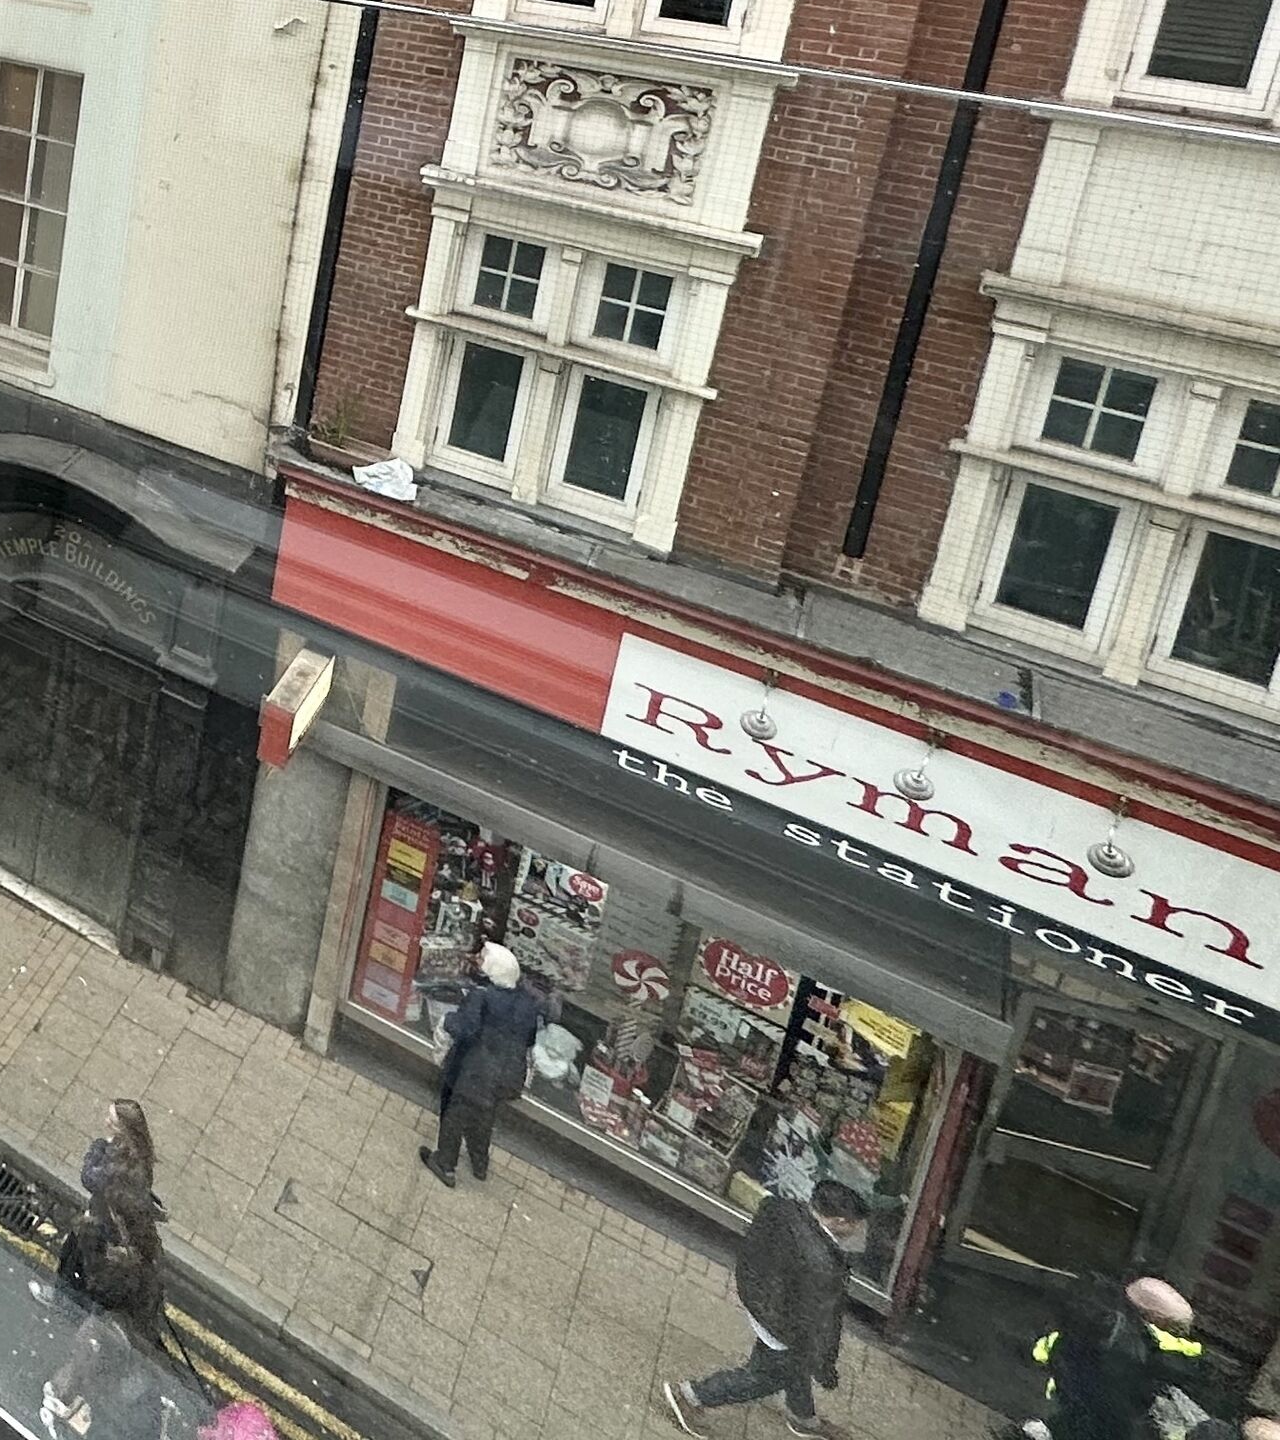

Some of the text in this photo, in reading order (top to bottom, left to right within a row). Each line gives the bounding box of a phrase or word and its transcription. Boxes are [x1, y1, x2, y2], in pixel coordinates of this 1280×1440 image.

[612, 749, 1256, 1026] the stationer
[625, 681, 1265, 970] Ryman
[715, 964, 772, 1002] Price
[718, 947, 780, 986] Half
